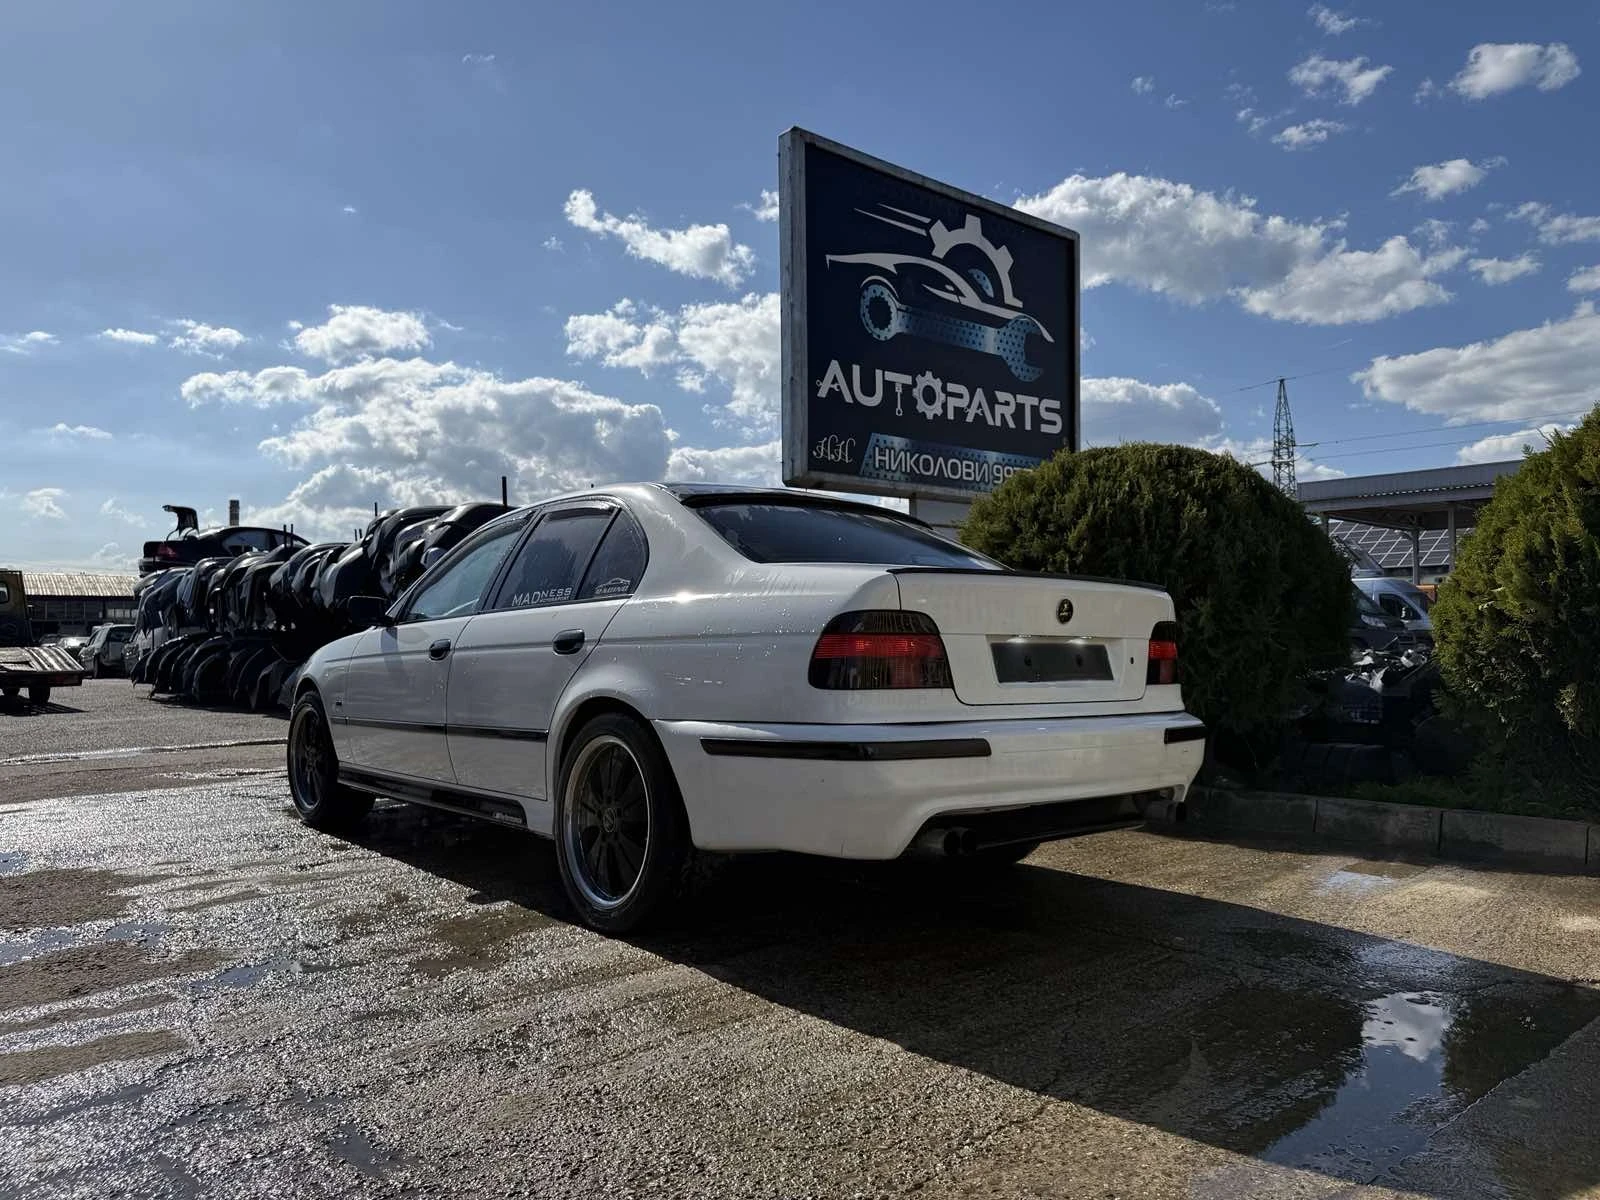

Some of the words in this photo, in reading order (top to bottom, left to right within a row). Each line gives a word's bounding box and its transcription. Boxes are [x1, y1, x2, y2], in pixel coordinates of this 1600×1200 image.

[816, 359, 1063, 434] AUTOPARTS
[874, 446, 989, 484] НИКОЛОВИ
[511, 587, 572, 607] MADNESS
